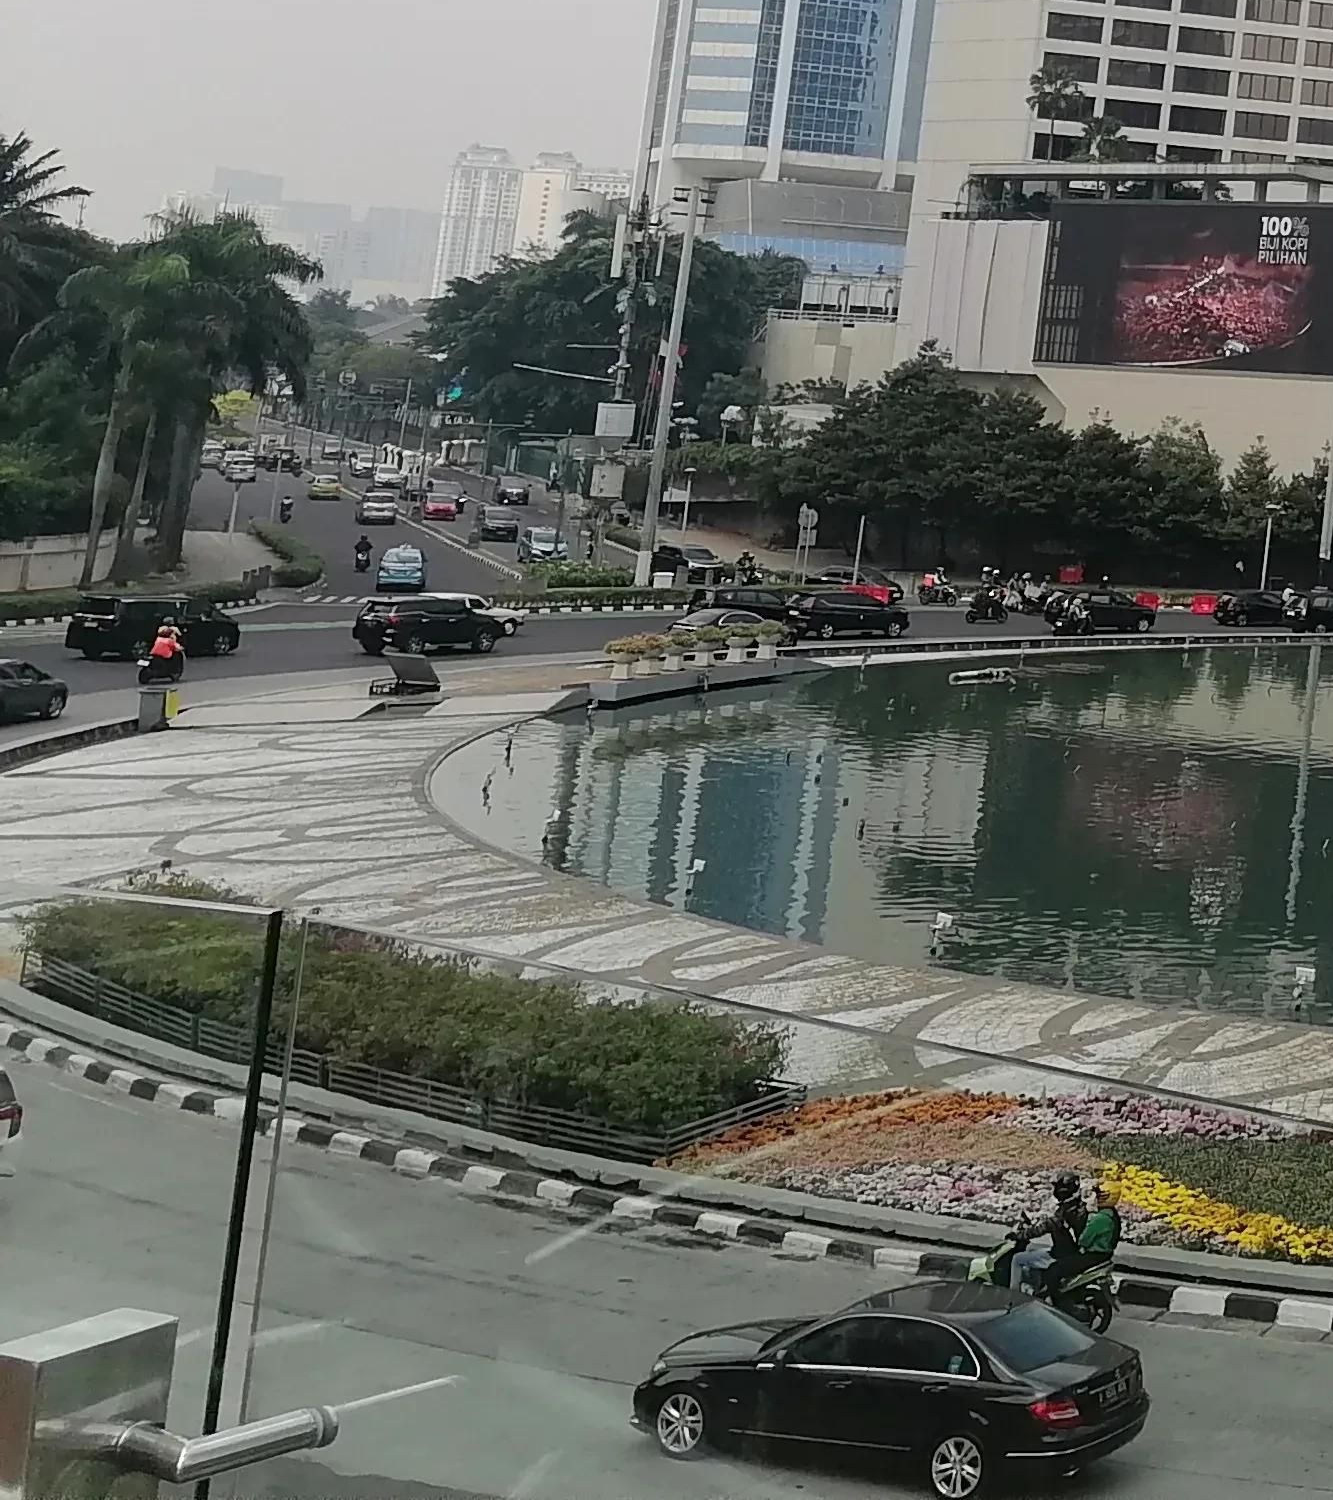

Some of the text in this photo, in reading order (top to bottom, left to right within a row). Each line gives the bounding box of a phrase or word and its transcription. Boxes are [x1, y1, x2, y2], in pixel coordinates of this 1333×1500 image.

[1261, 216, 1310, 237] 100%
[1259, 237, 1309, 252] BIJI KOPI
[1257, 250, 1308, 265] PILIHAN
